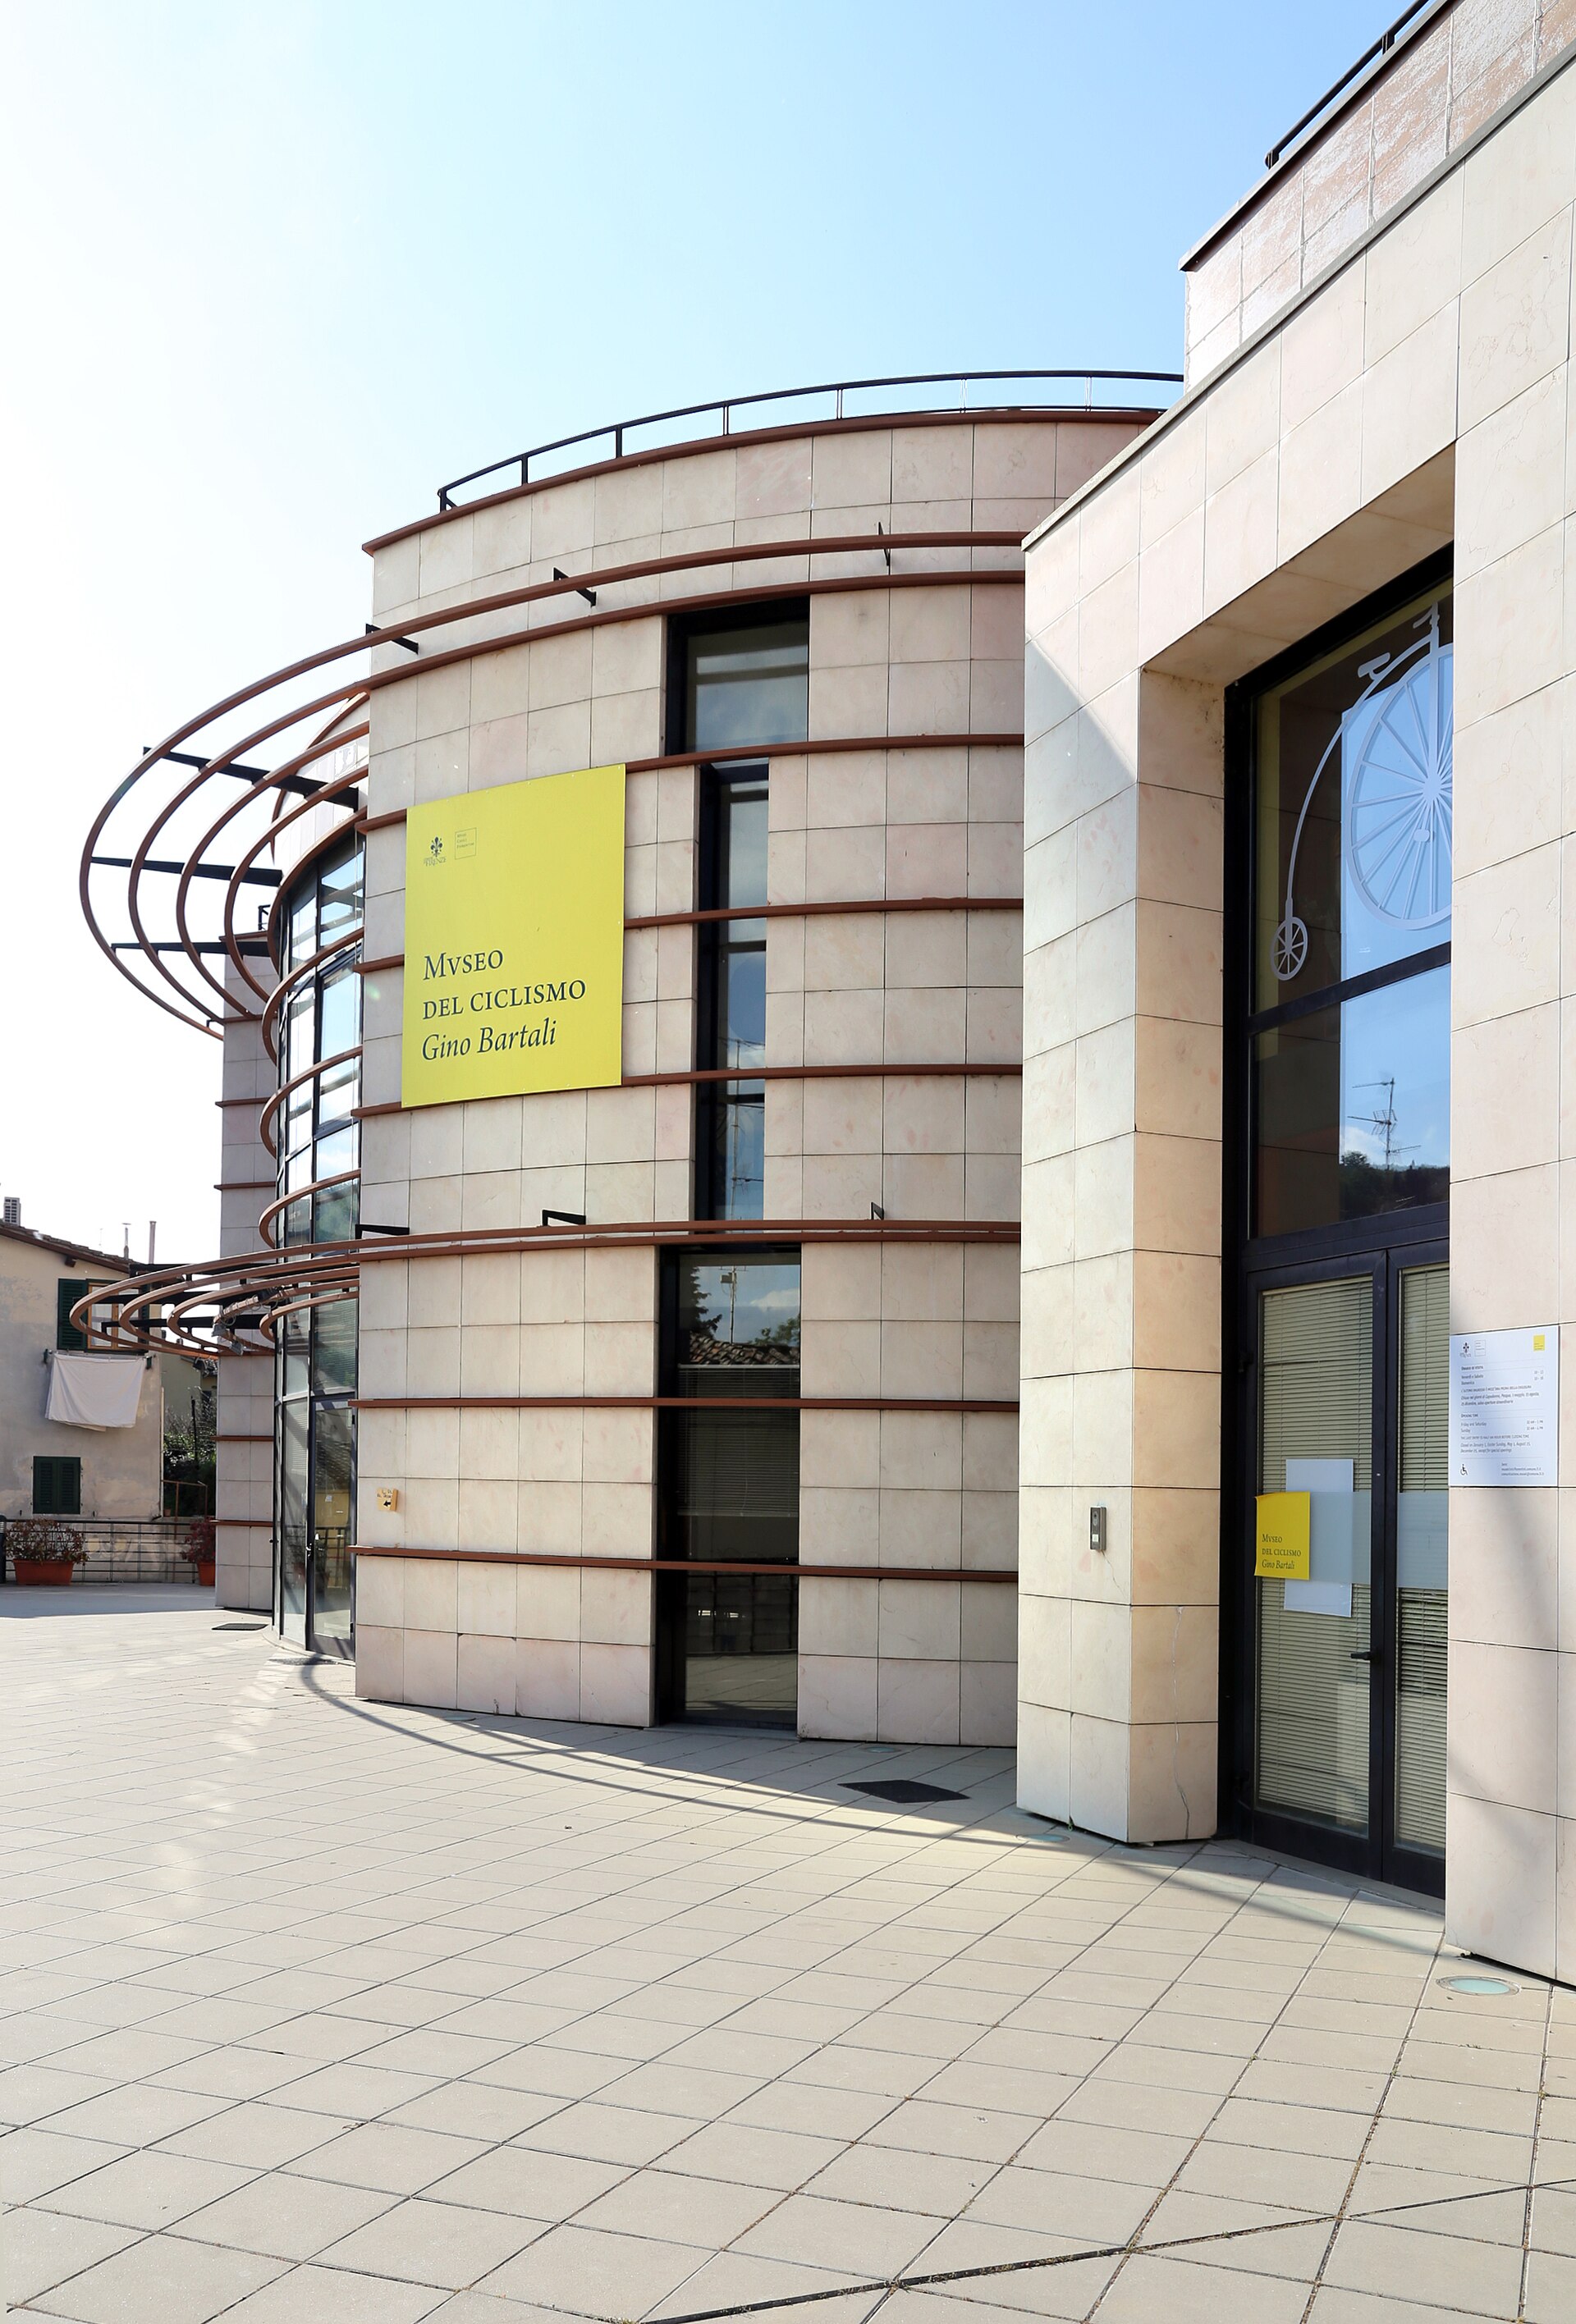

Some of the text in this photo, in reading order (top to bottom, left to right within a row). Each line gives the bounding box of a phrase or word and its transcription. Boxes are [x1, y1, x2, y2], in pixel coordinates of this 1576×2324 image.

[423, 949, 503, 981] MVSEO
[423, 979, 586, 1019] DEL CICLISMO
[422, 1017, 557, 1060] Gino Bartali
[1262, 1559, 1294, 1569] Gino Bartali
[1274, 1549, 1301, 1557] CICLISMO
